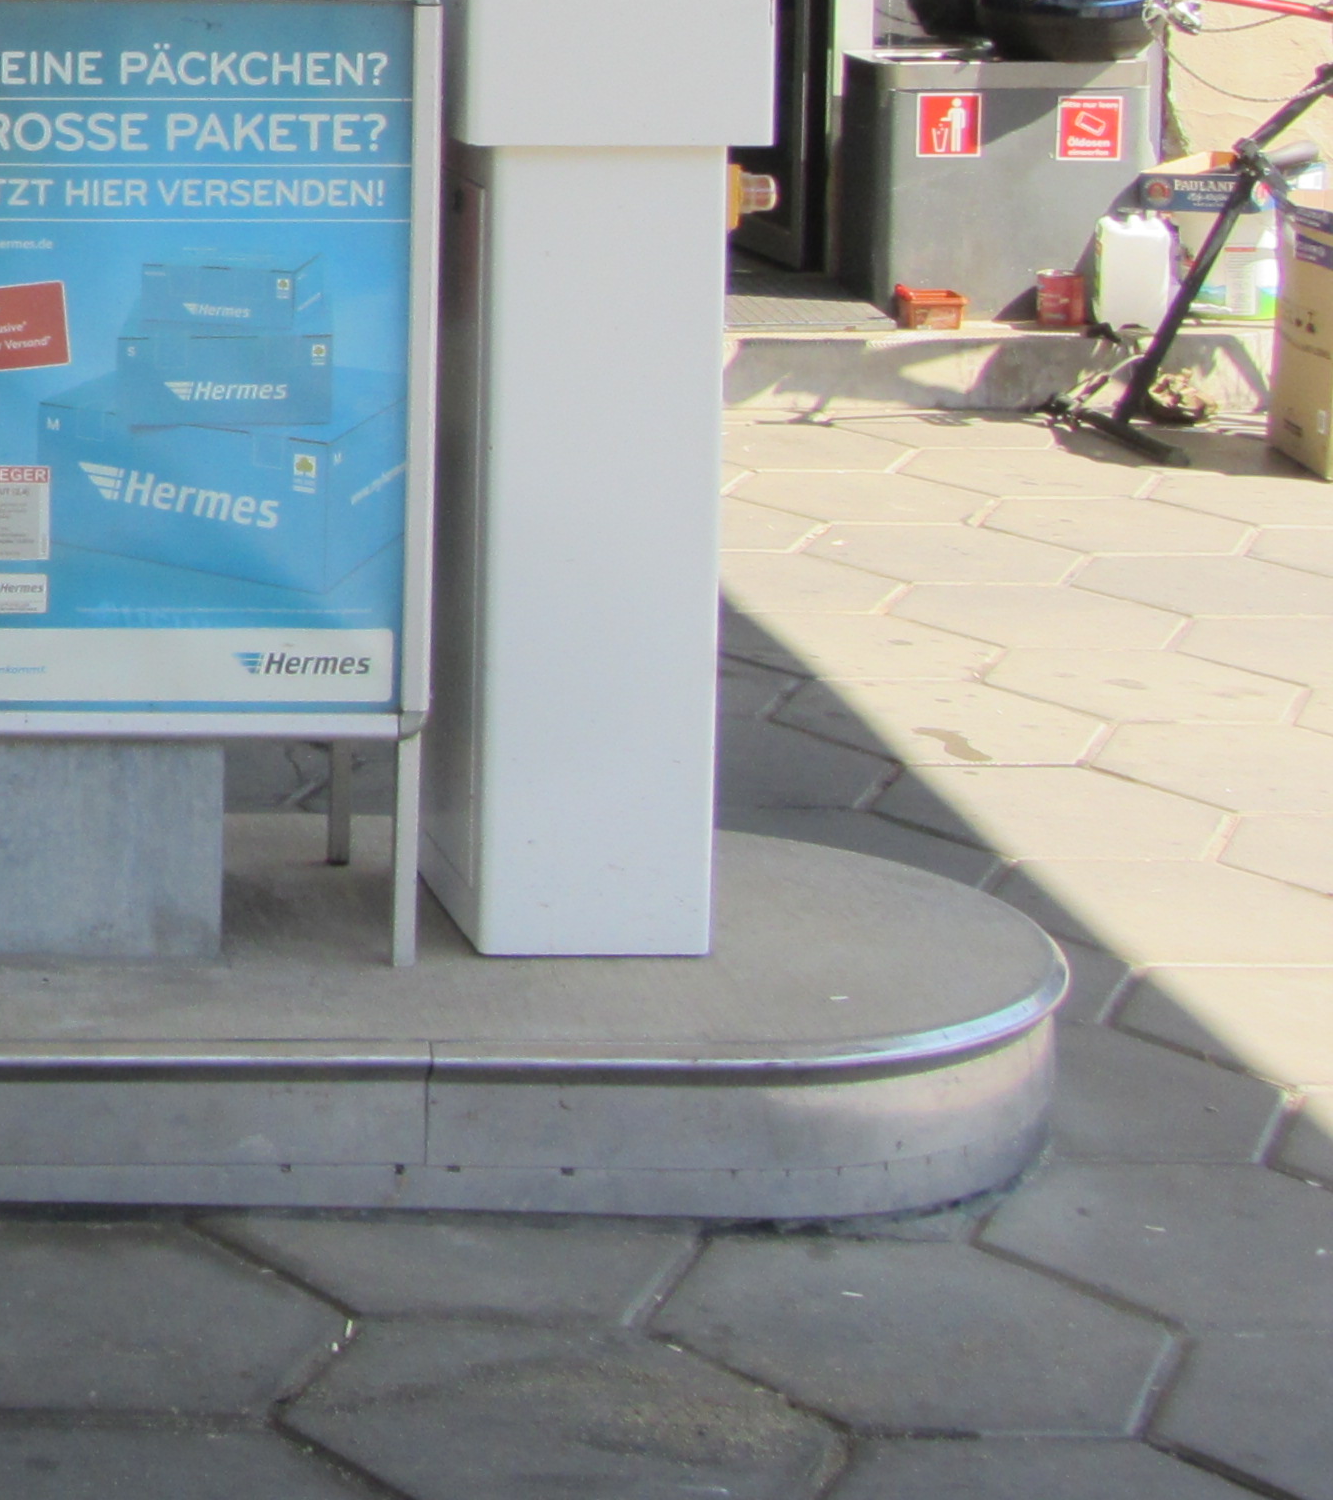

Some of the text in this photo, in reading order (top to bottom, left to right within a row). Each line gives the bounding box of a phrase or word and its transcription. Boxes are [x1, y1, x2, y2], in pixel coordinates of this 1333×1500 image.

[119, 42, 389, 87] PÄCKCHEN?
[166, 113, 387, 152] PAKETE?
[1066, 136, 1111, 147] Öldosen
[65, 180, 147, 207] HIER
[158, 179, 385, 207] VERSENDEN!
[198, 304, 251, 319] Hermes
[193, 381, 288, 401] Hermes
[47, 417, 60, 431] M
[123, 471, 280, 529] Hermes
[0, 583, 44, 593] Hermes
[264, 652, 371, 675] Hermes
